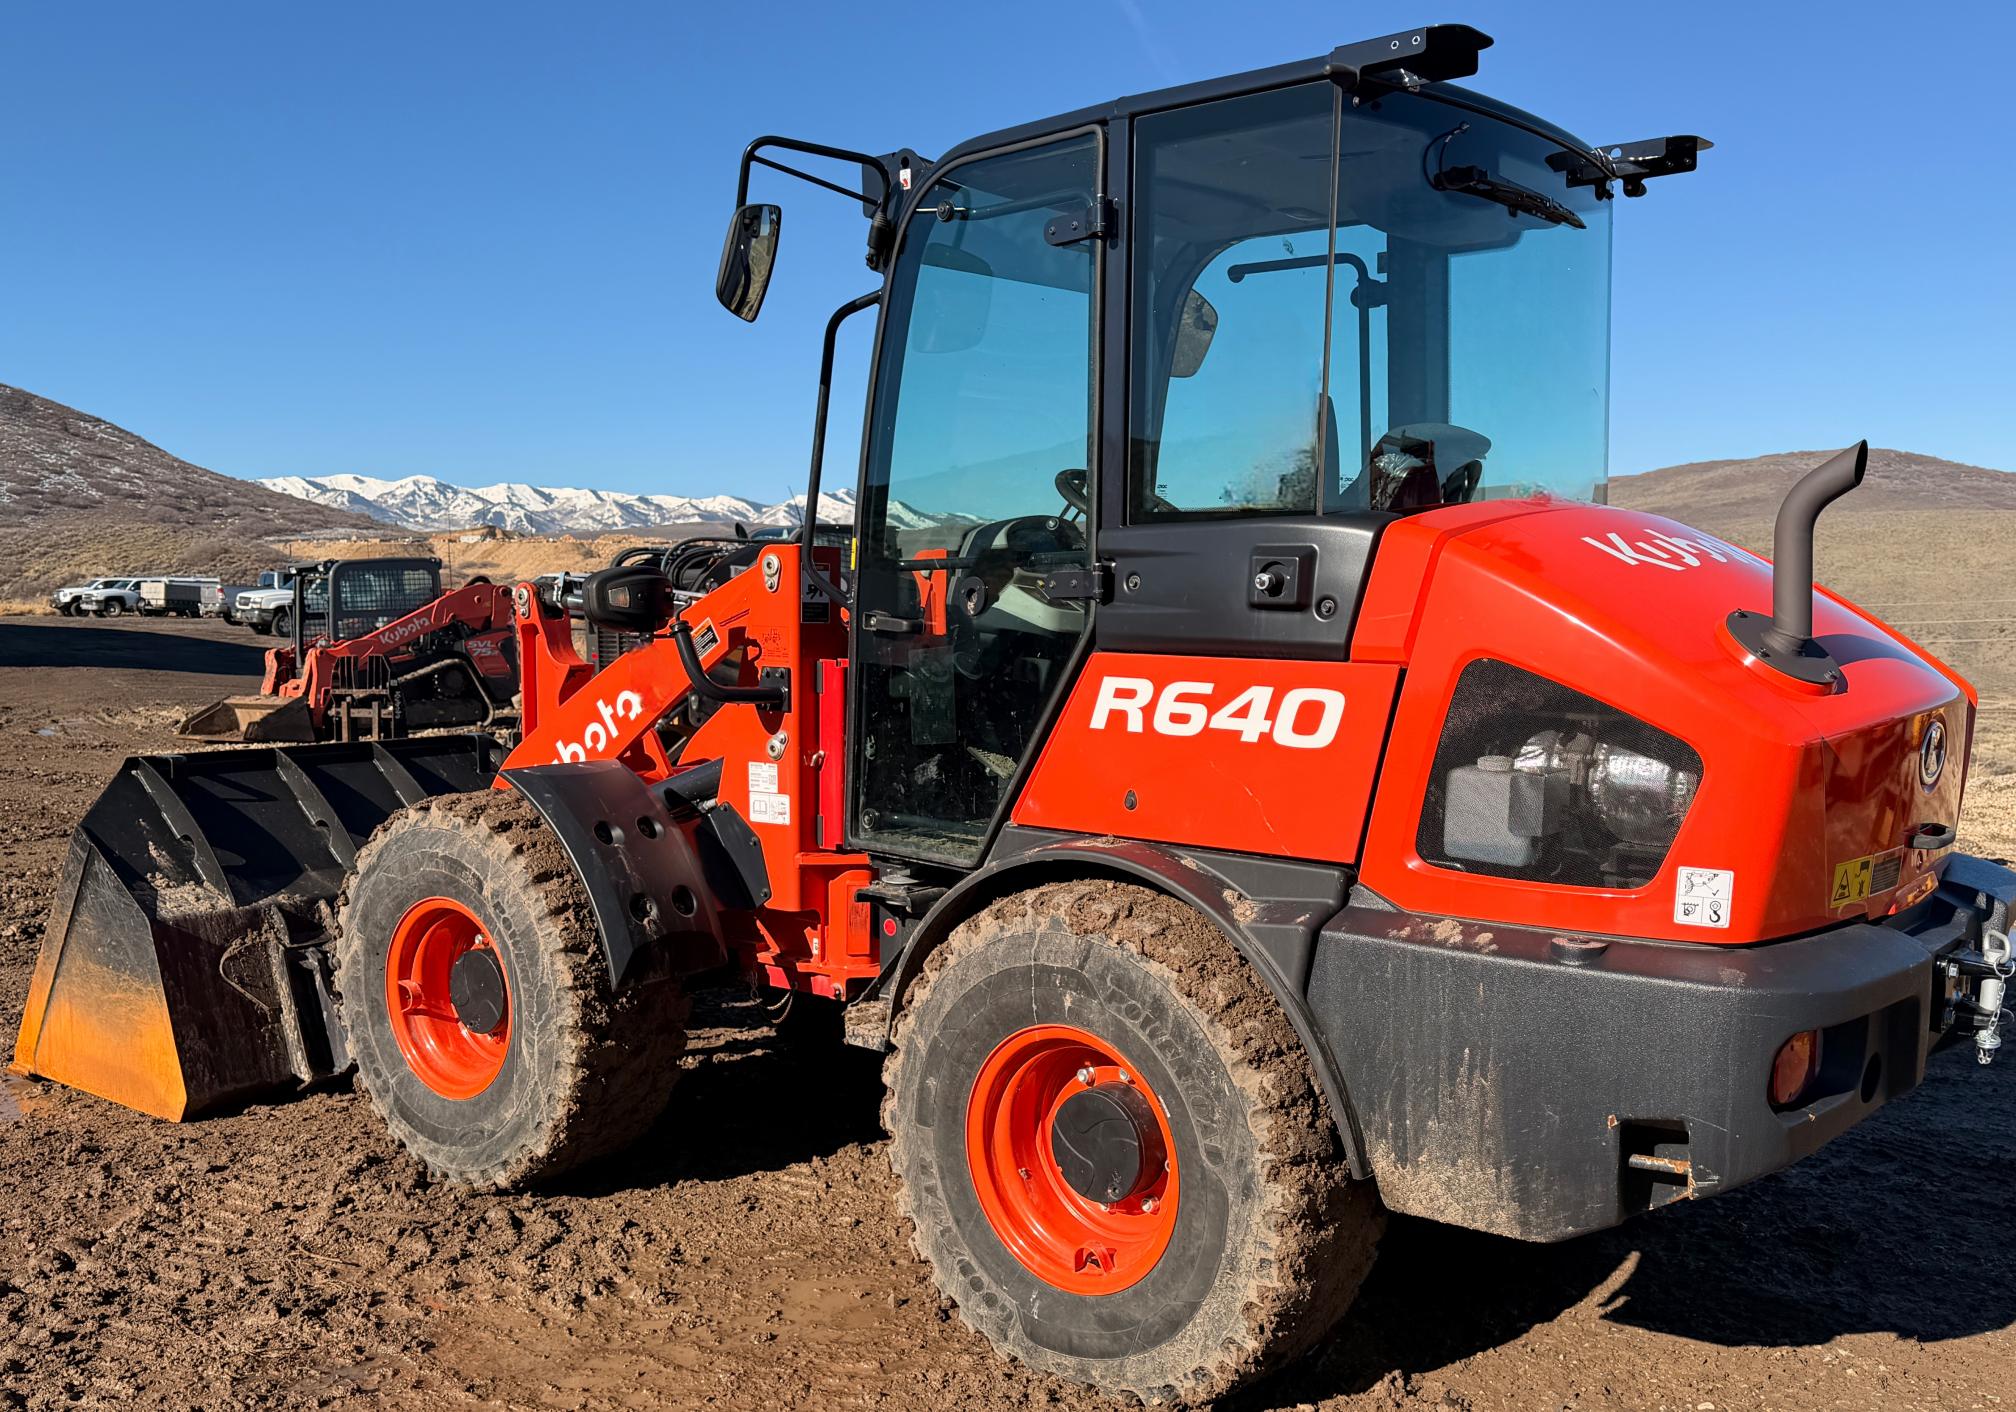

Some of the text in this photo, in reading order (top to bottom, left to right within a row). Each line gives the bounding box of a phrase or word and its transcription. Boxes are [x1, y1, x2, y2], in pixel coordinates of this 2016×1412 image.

[379, 616, 431, 644] Kubota
[467, 639, 497, 649] SVL
[1089, 675, 1346, 749] R640
